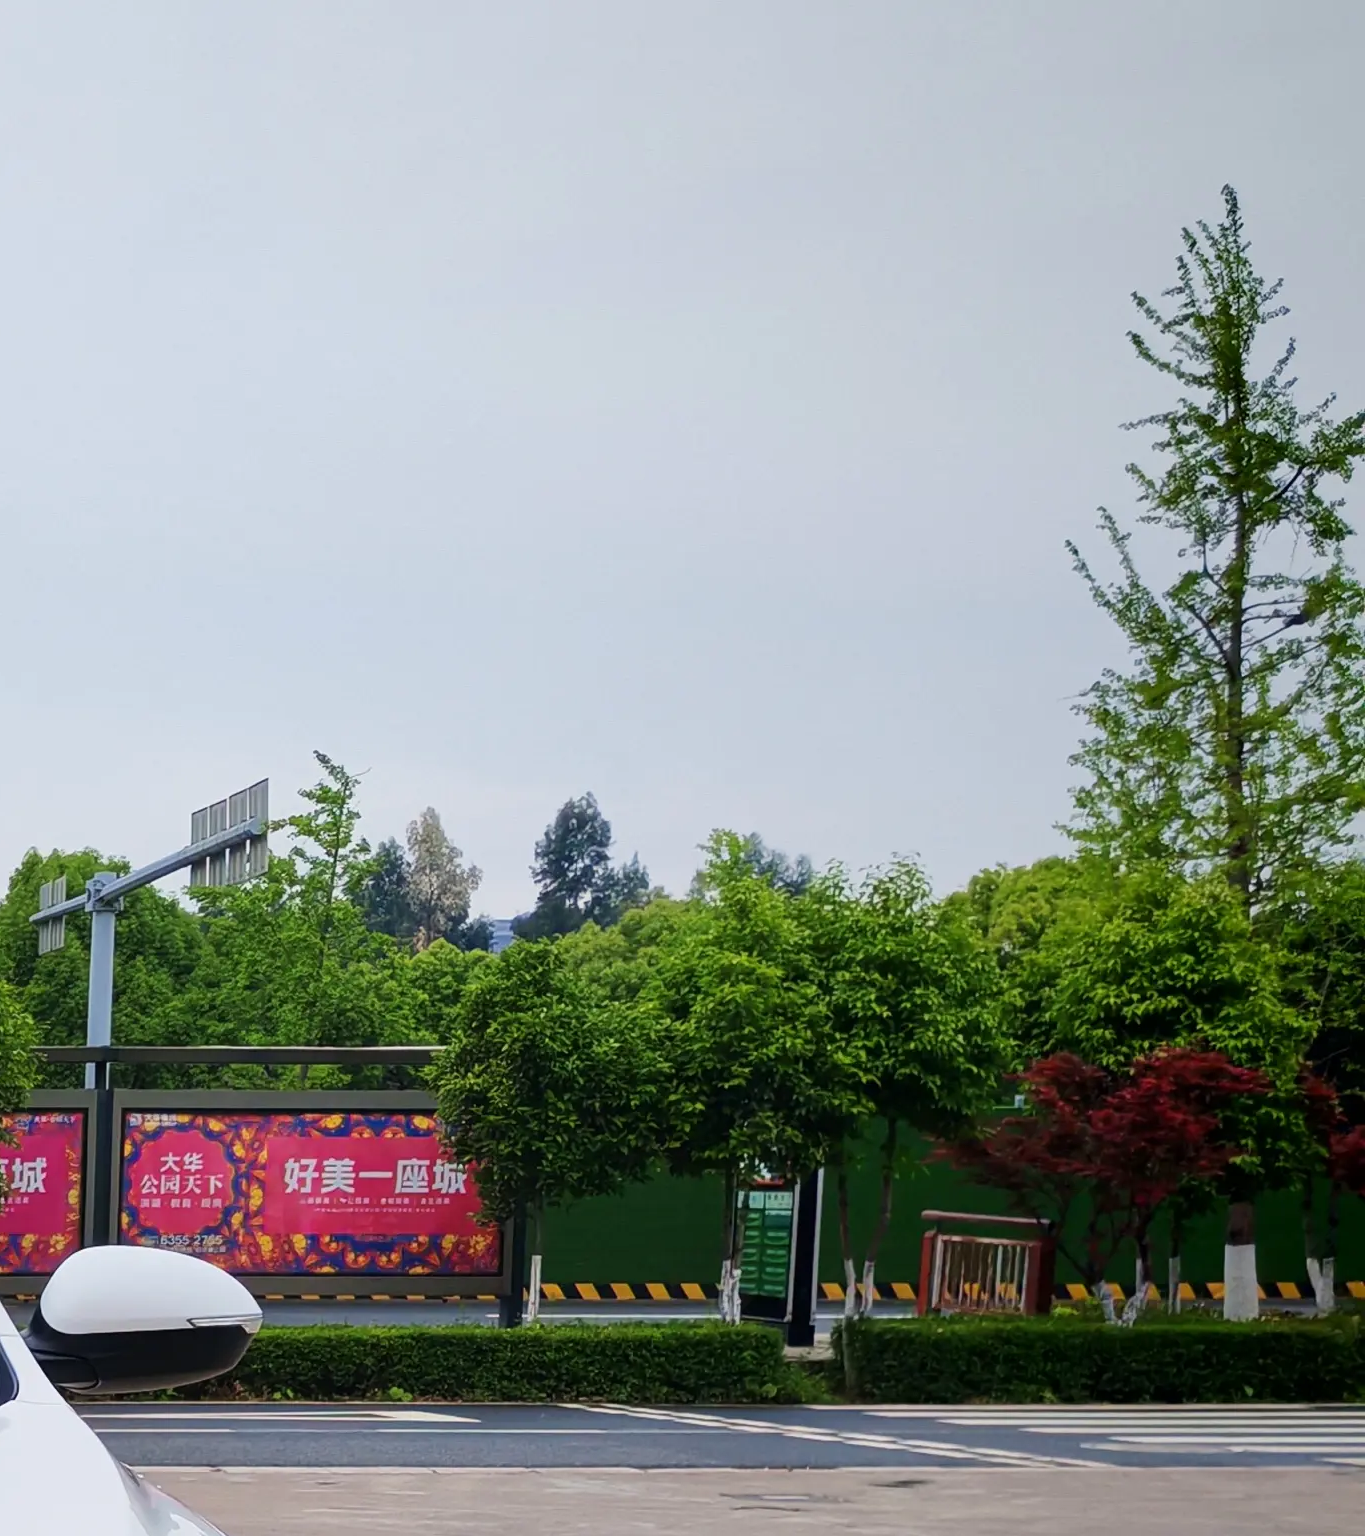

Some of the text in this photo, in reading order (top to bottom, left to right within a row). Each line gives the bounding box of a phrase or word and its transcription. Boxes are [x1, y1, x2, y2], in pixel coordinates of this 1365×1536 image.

[160, 1152, 204, 1173] 大华
[140, 1174, 225, 1195] 公园天下
[284, 1158, 468, 1194] 好美一座城
